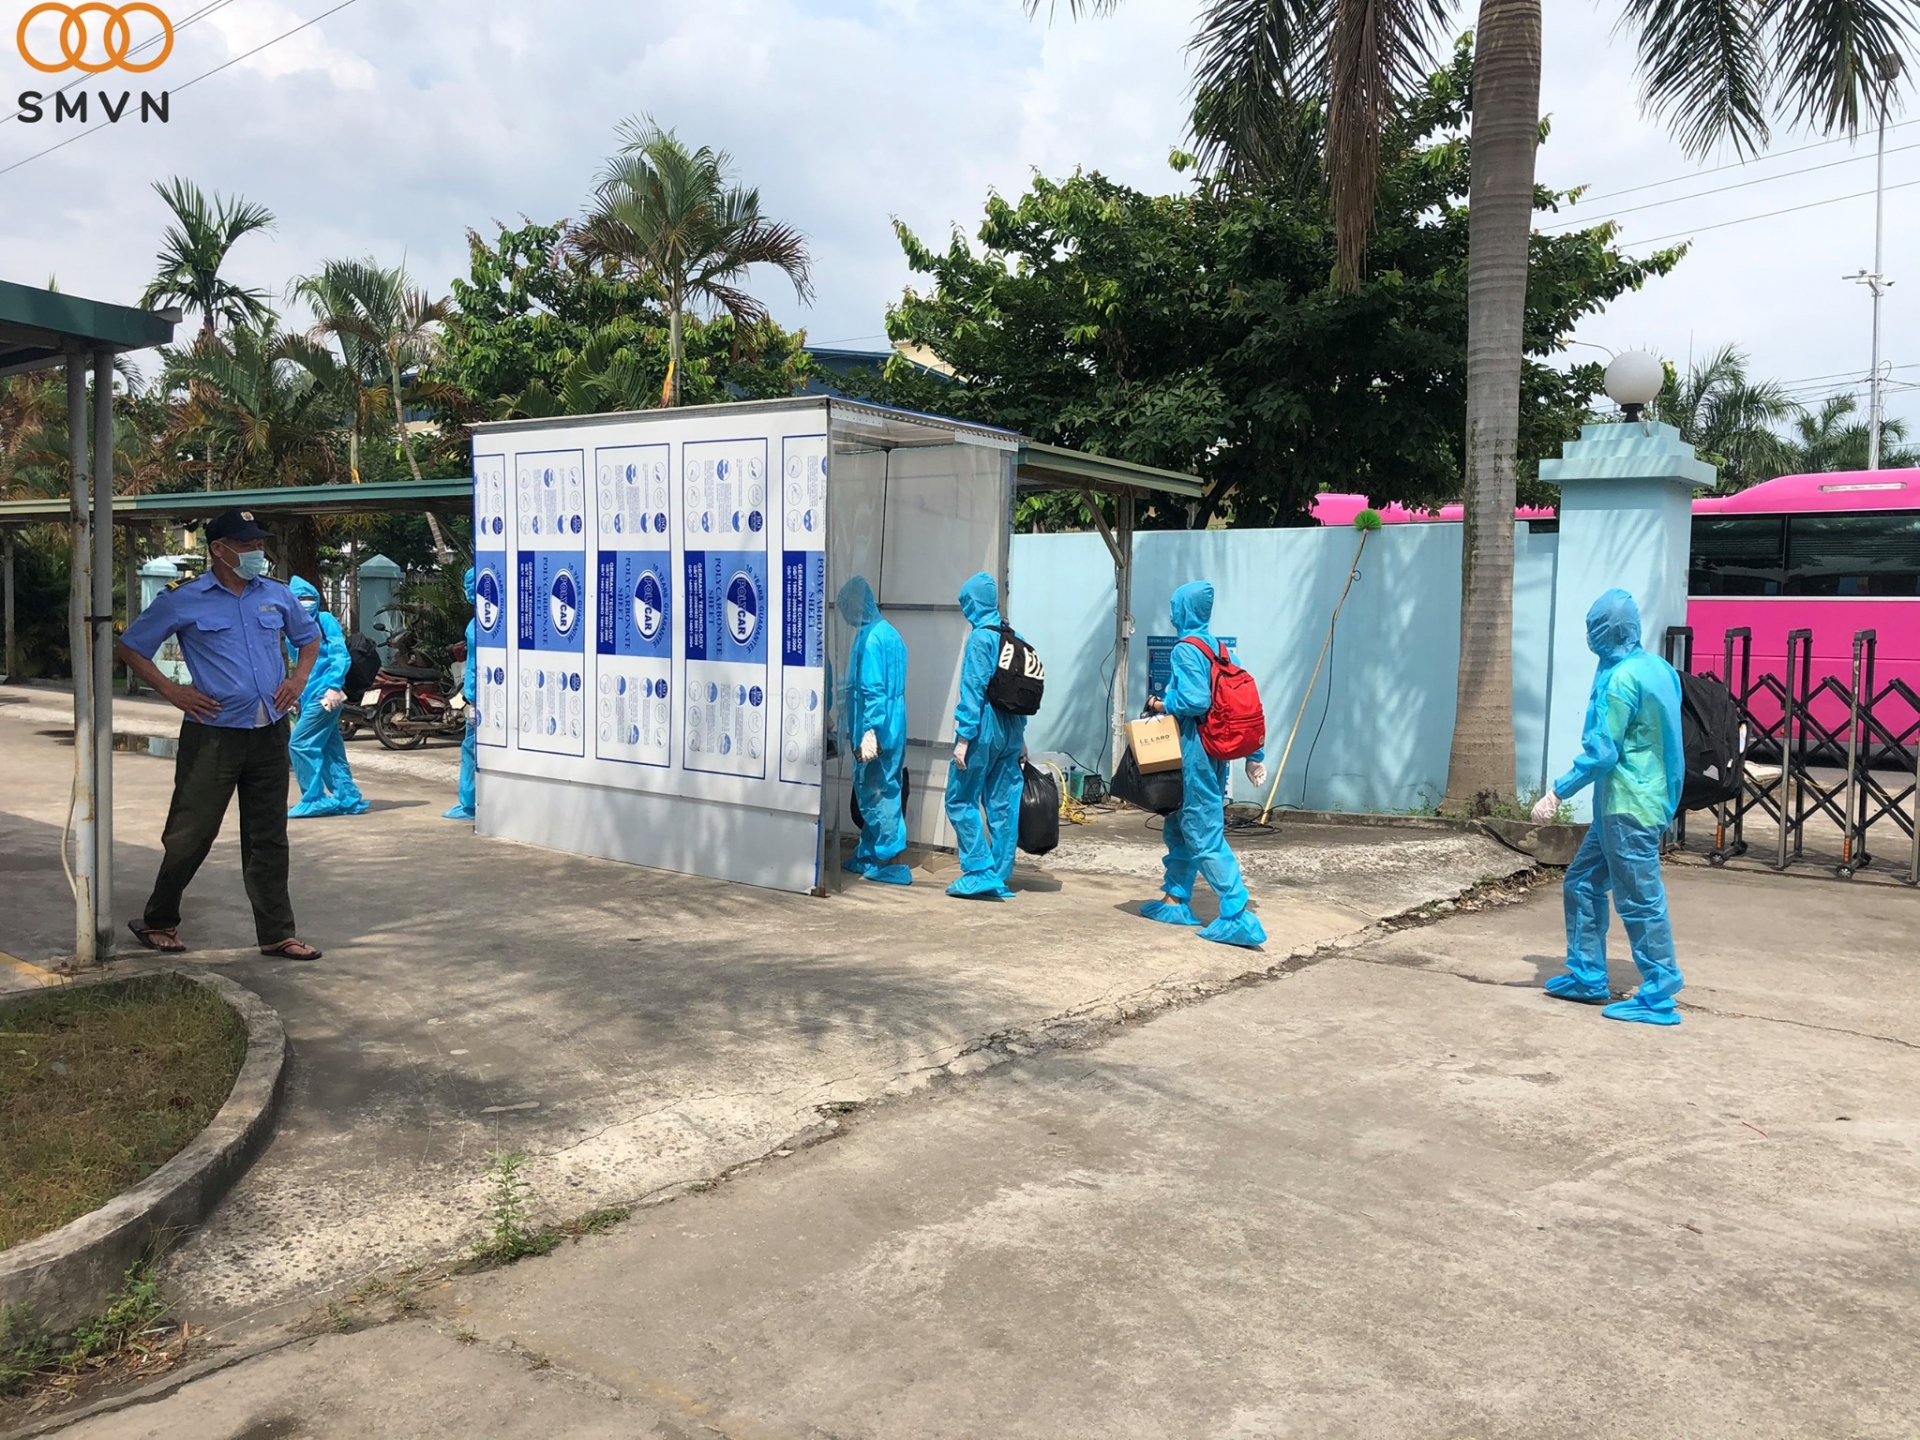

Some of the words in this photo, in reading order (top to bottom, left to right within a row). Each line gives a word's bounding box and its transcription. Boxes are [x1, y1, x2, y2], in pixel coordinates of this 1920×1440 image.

[645, 577, 653, 630] POLYCAR
[659, 572, 667, 598] YEARS
[737, 579, 746, 634] POLYCAR
[754, 574, 763, 600] YEARS
[567, 600, 582, 643] GUARANTEE
[652, 603, 669, 648] GUARANTEE
[746, 606, 764, 654] GUARANTEE
